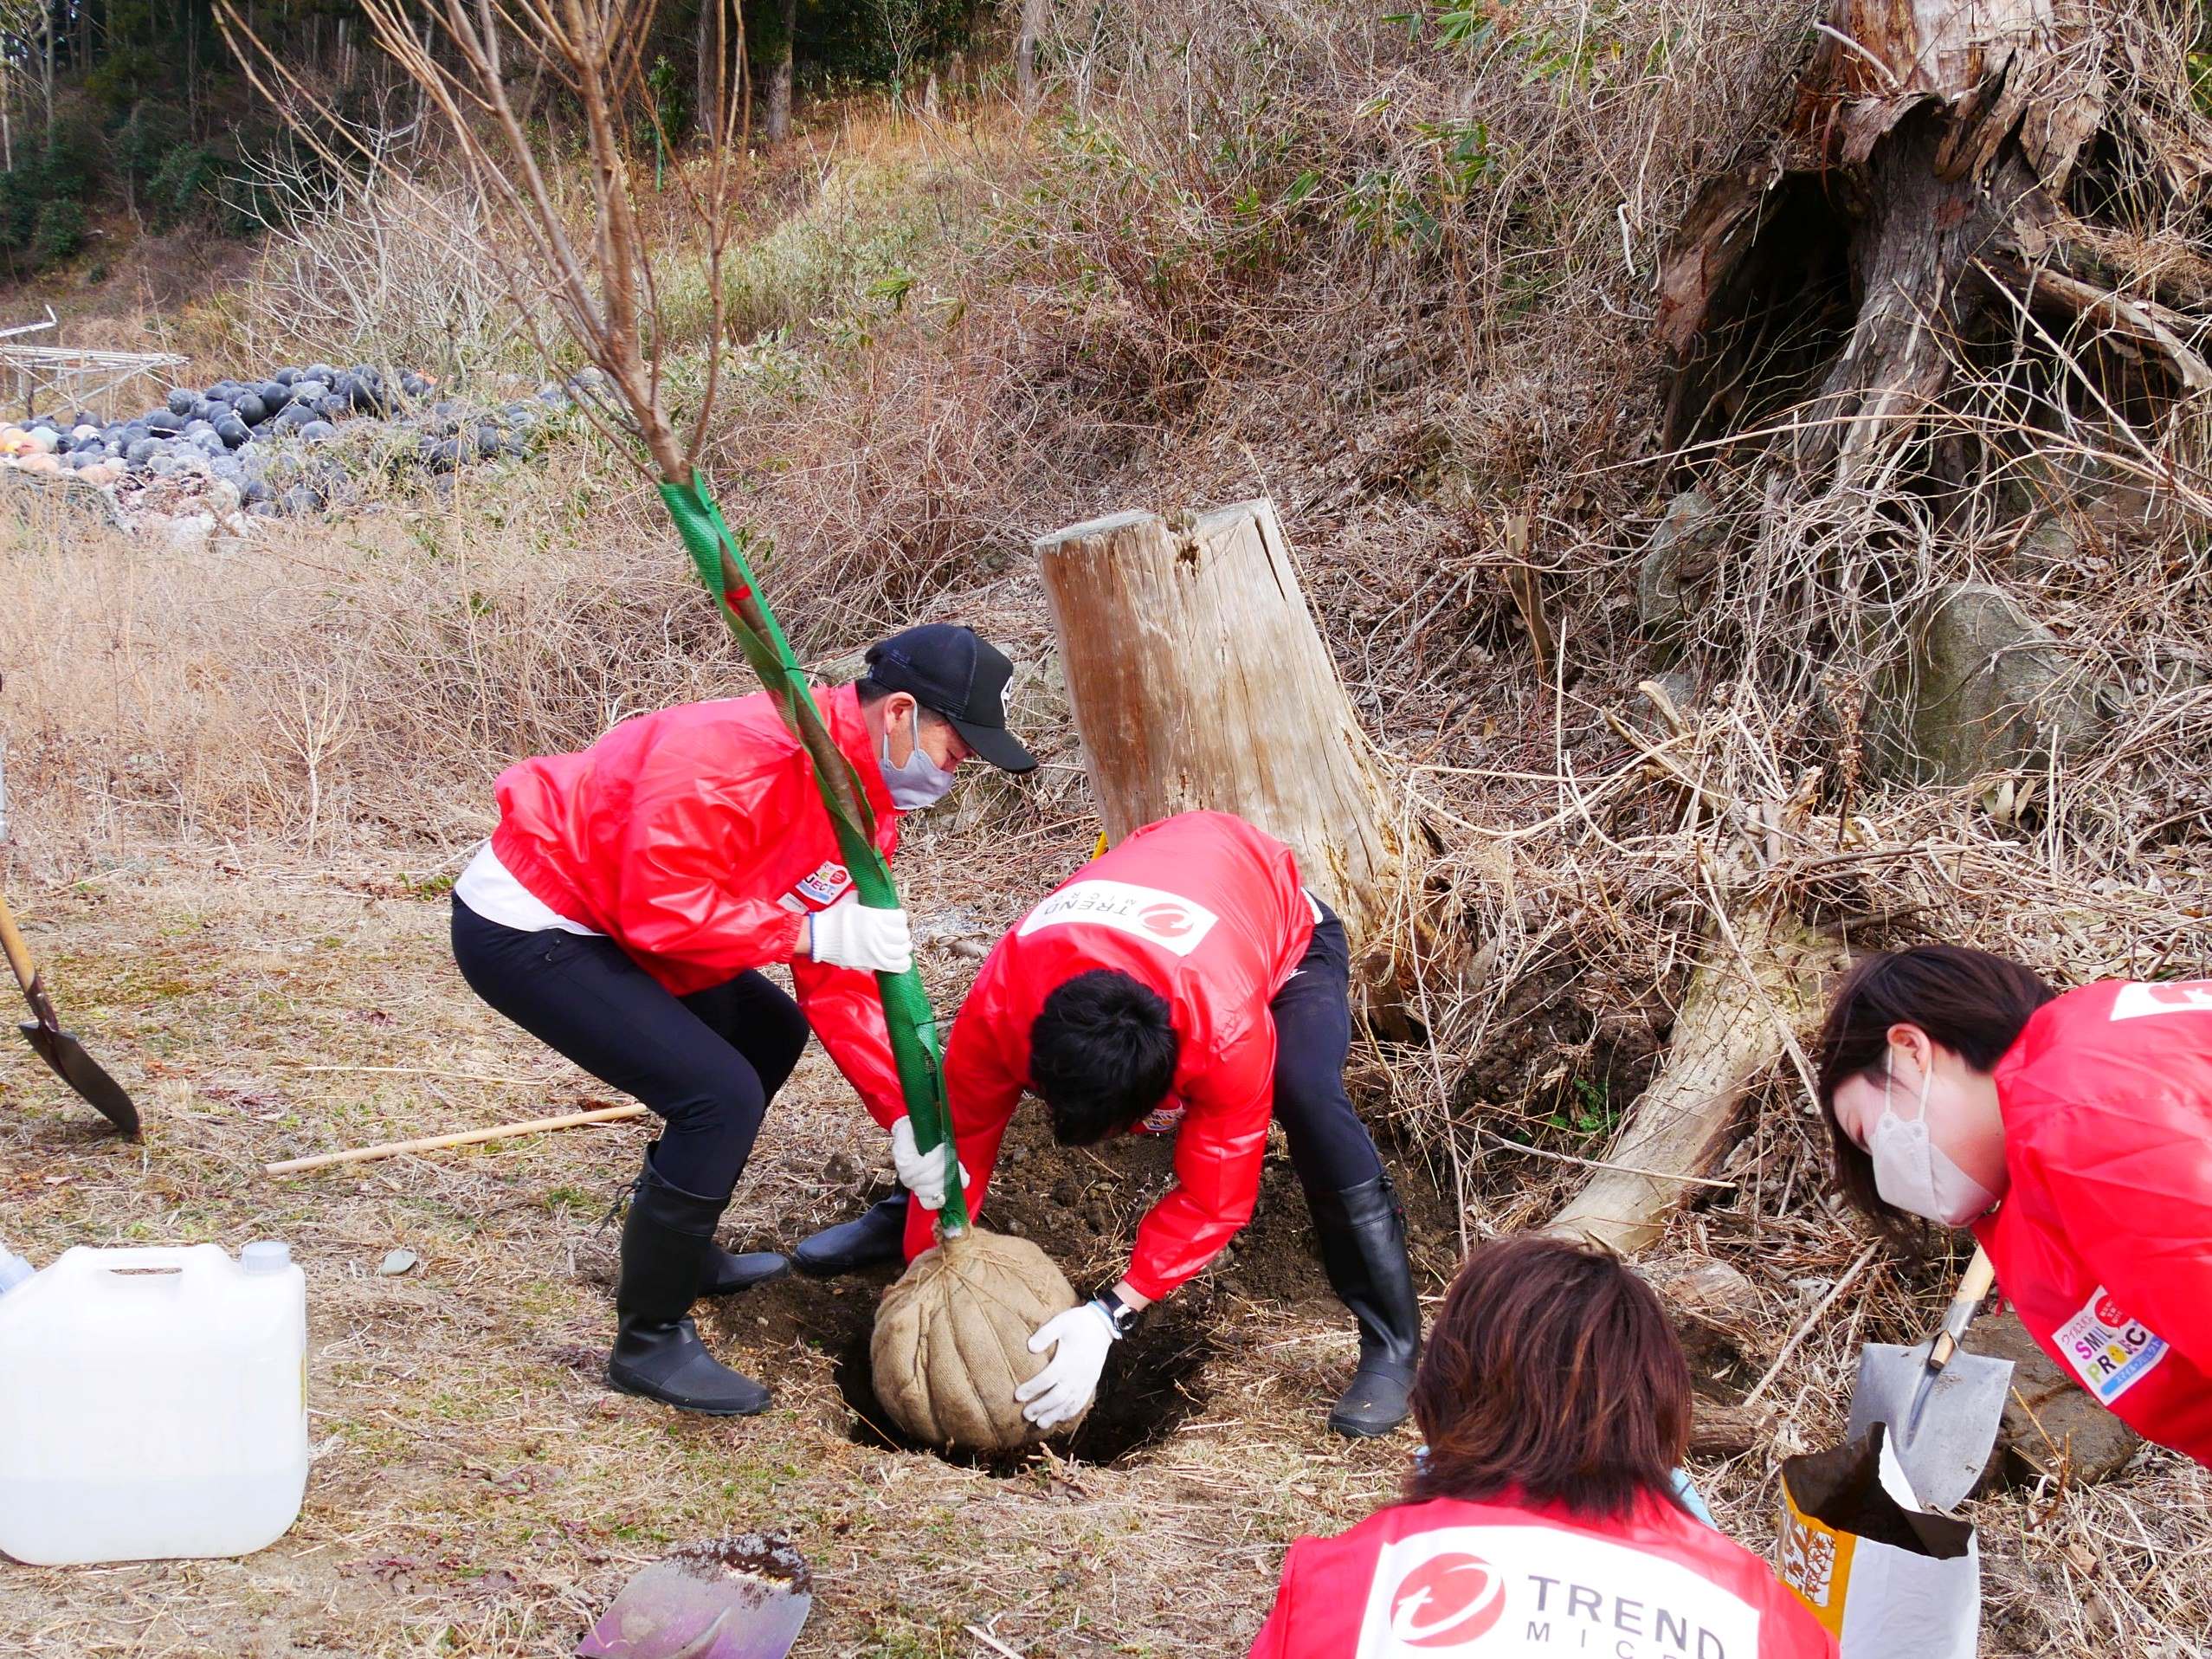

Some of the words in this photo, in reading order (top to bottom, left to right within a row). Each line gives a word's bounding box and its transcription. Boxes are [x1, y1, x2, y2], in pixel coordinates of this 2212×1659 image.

[1044, 898, 1128, 916] TREND
[2075, 1326, 2115, 1360] SMIL
[1528, 1574, 1725, 1659] TREND
[1526, 1621, 1677, 1659] MIC
